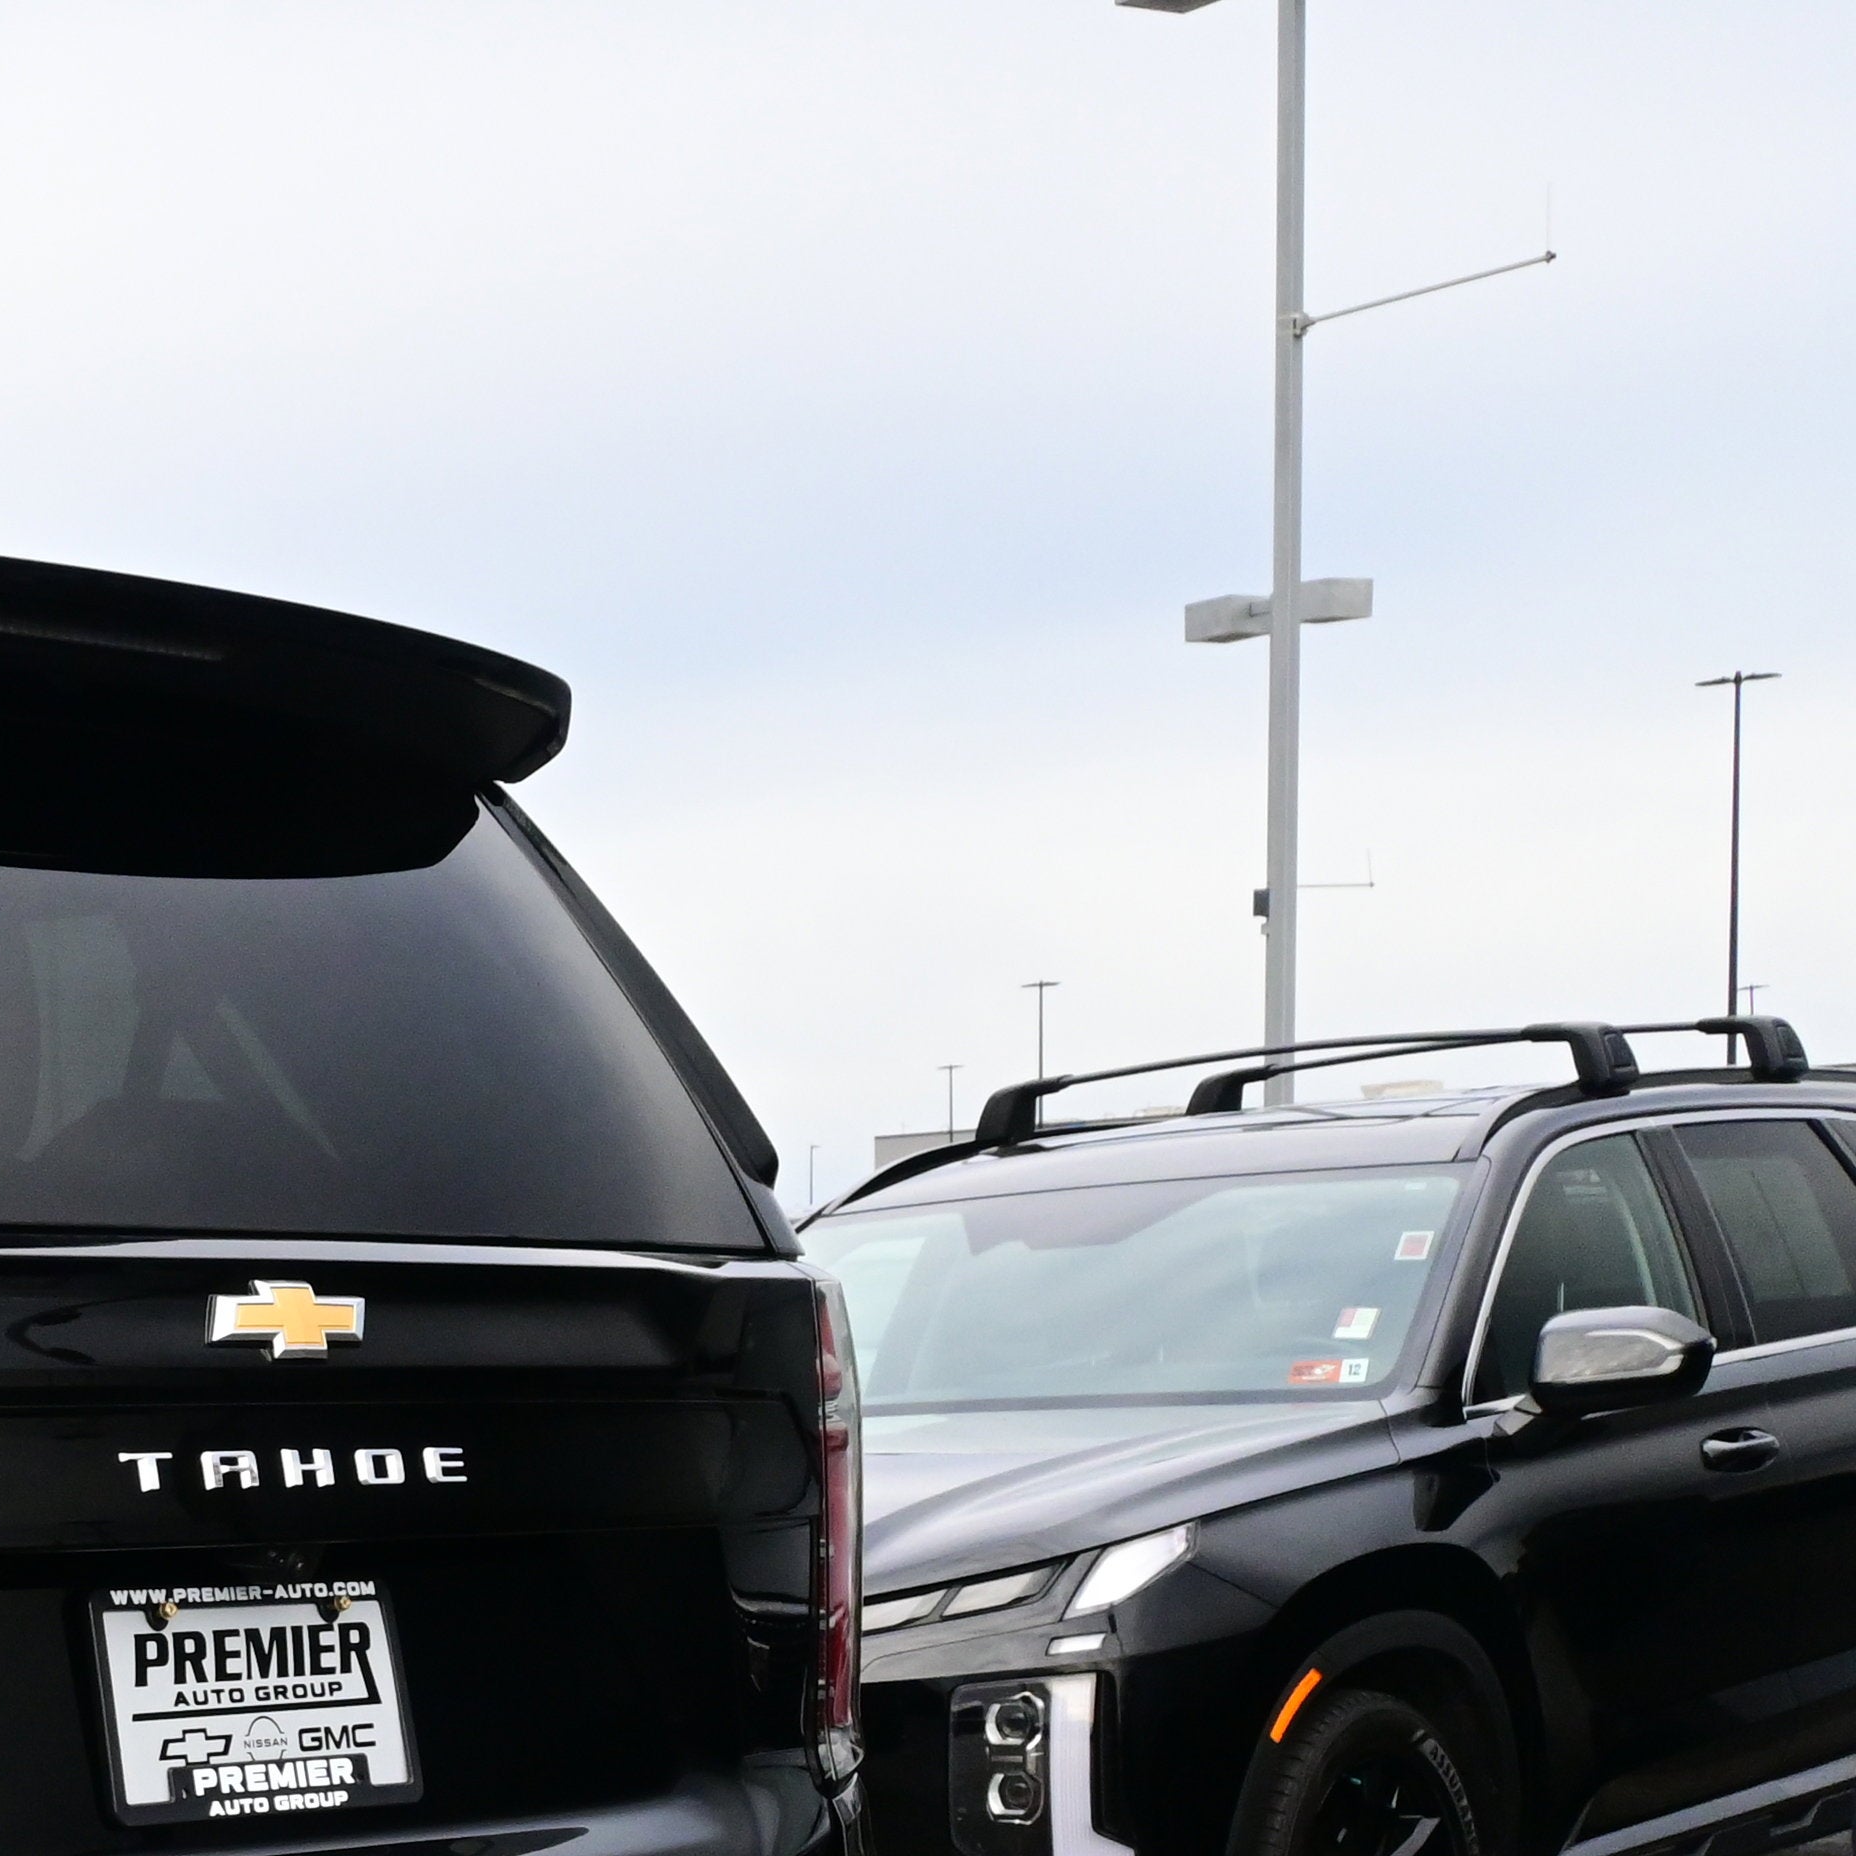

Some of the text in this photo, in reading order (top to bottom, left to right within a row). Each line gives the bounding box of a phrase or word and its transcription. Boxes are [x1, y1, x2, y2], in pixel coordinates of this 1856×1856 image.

[117, 1446, 469, 1493] TAHOE
[109, 1580, 377, 1606] WWW.PREMIER-AUTO.COM
[133, 1621, 373, 1688] PREMIER
[174, 1681, 344, 1708] AUTO GROUP
[243, 1722, 377, 1752] NISSAN GMC
[192, 1757, 356, 1798] PREMIER
[208, 1790, 350, 1818] AUTO GROUP
